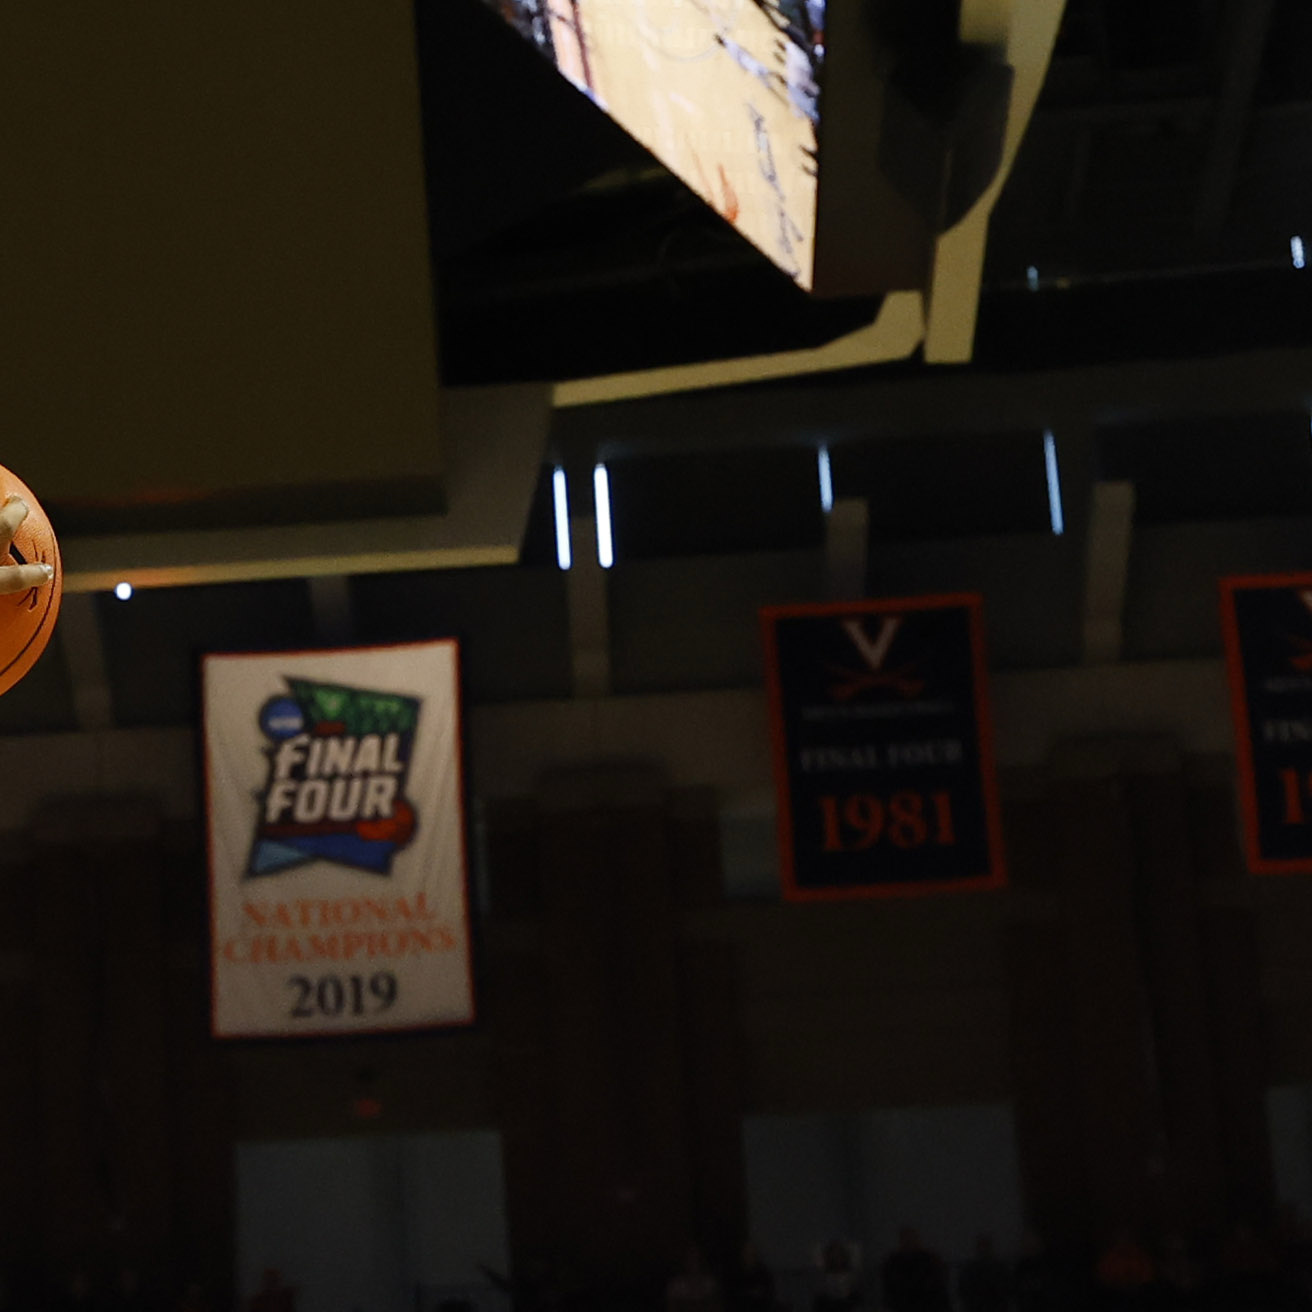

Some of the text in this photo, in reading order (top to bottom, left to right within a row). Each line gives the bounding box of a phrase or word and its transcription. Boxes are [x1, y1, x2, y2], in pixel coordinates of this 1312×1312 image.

[265, 733, 405, 824] FINAL FOUR
[817, 788, 957, 853] 1981
[242, 891, 439, 929] NATIONAL
[223, 925, 458, 965] CHAMPIONS
[288, 971, 398, 1019] 2019
